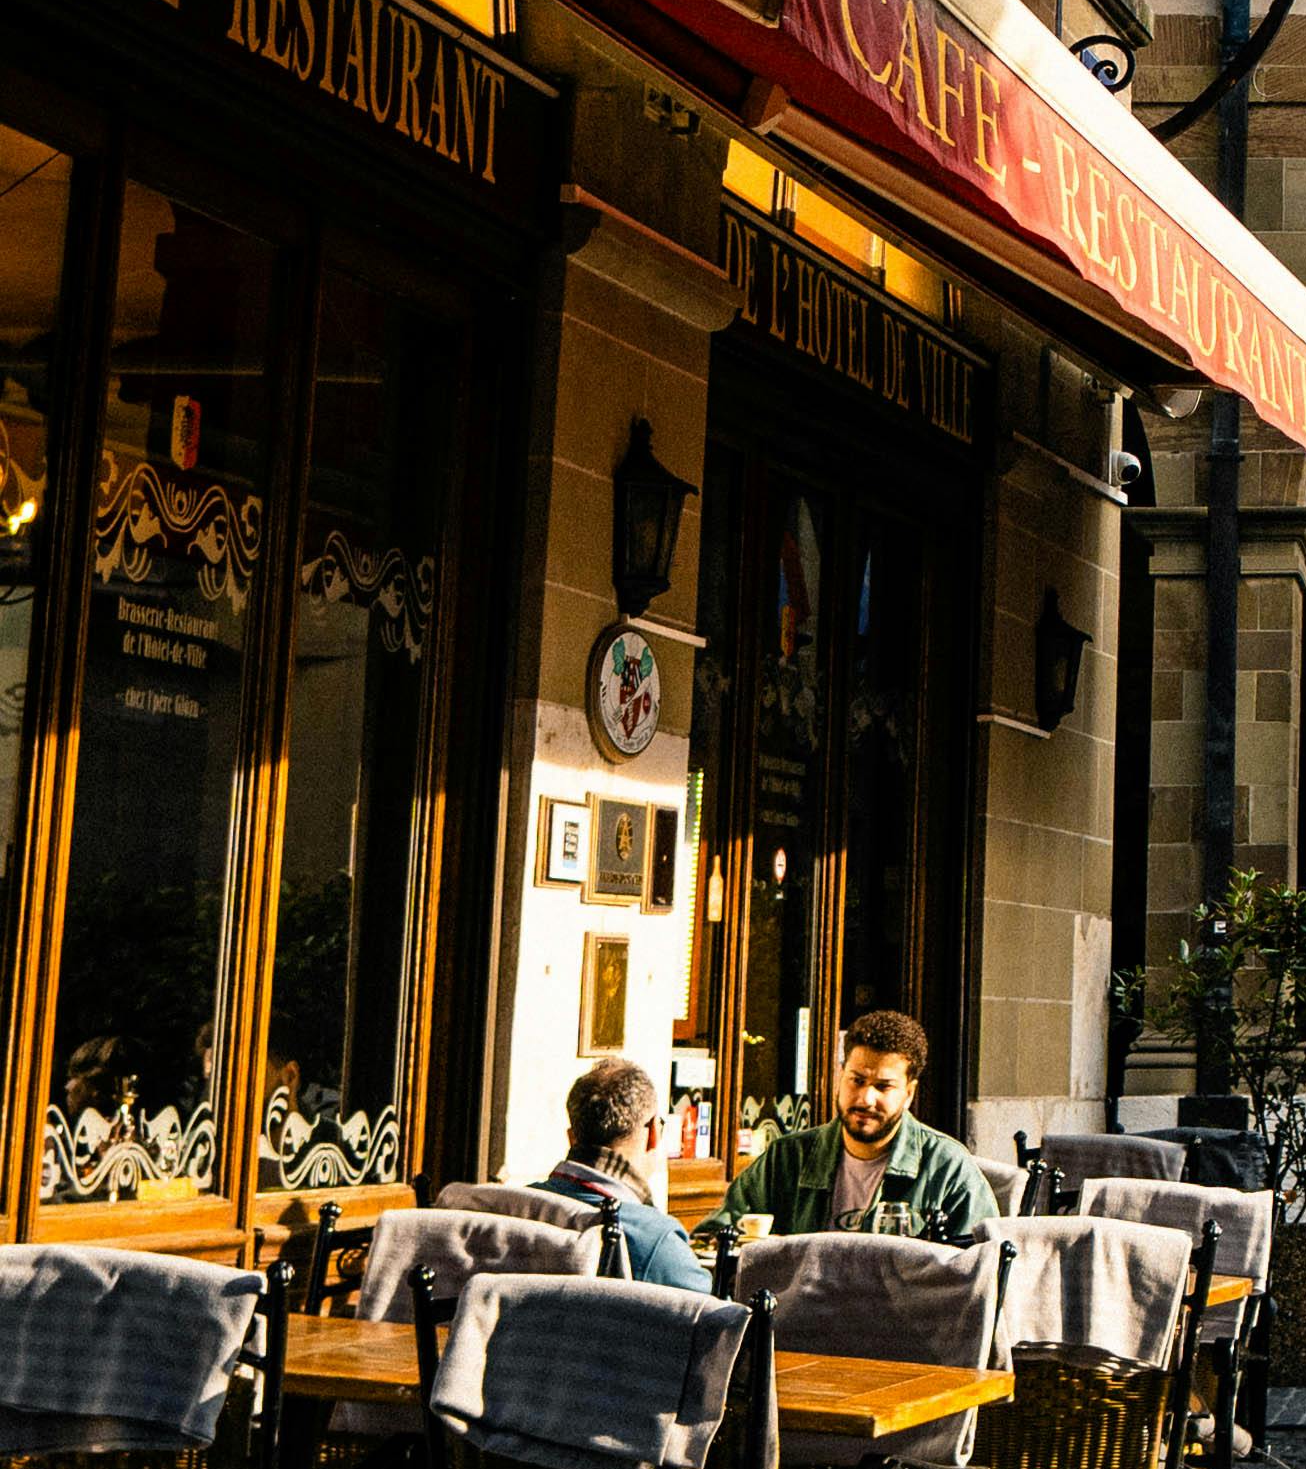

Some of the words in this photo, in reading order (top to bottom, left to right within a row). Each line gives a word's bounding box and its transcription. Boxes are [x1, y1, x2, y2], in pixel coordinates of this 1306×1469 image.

[725, 213, 759, 326] DE
[768, 242, 875, 391] L'HOTEL
[882, 312, 911, 411] DE
[916, 334, 975, 445] VILLE
